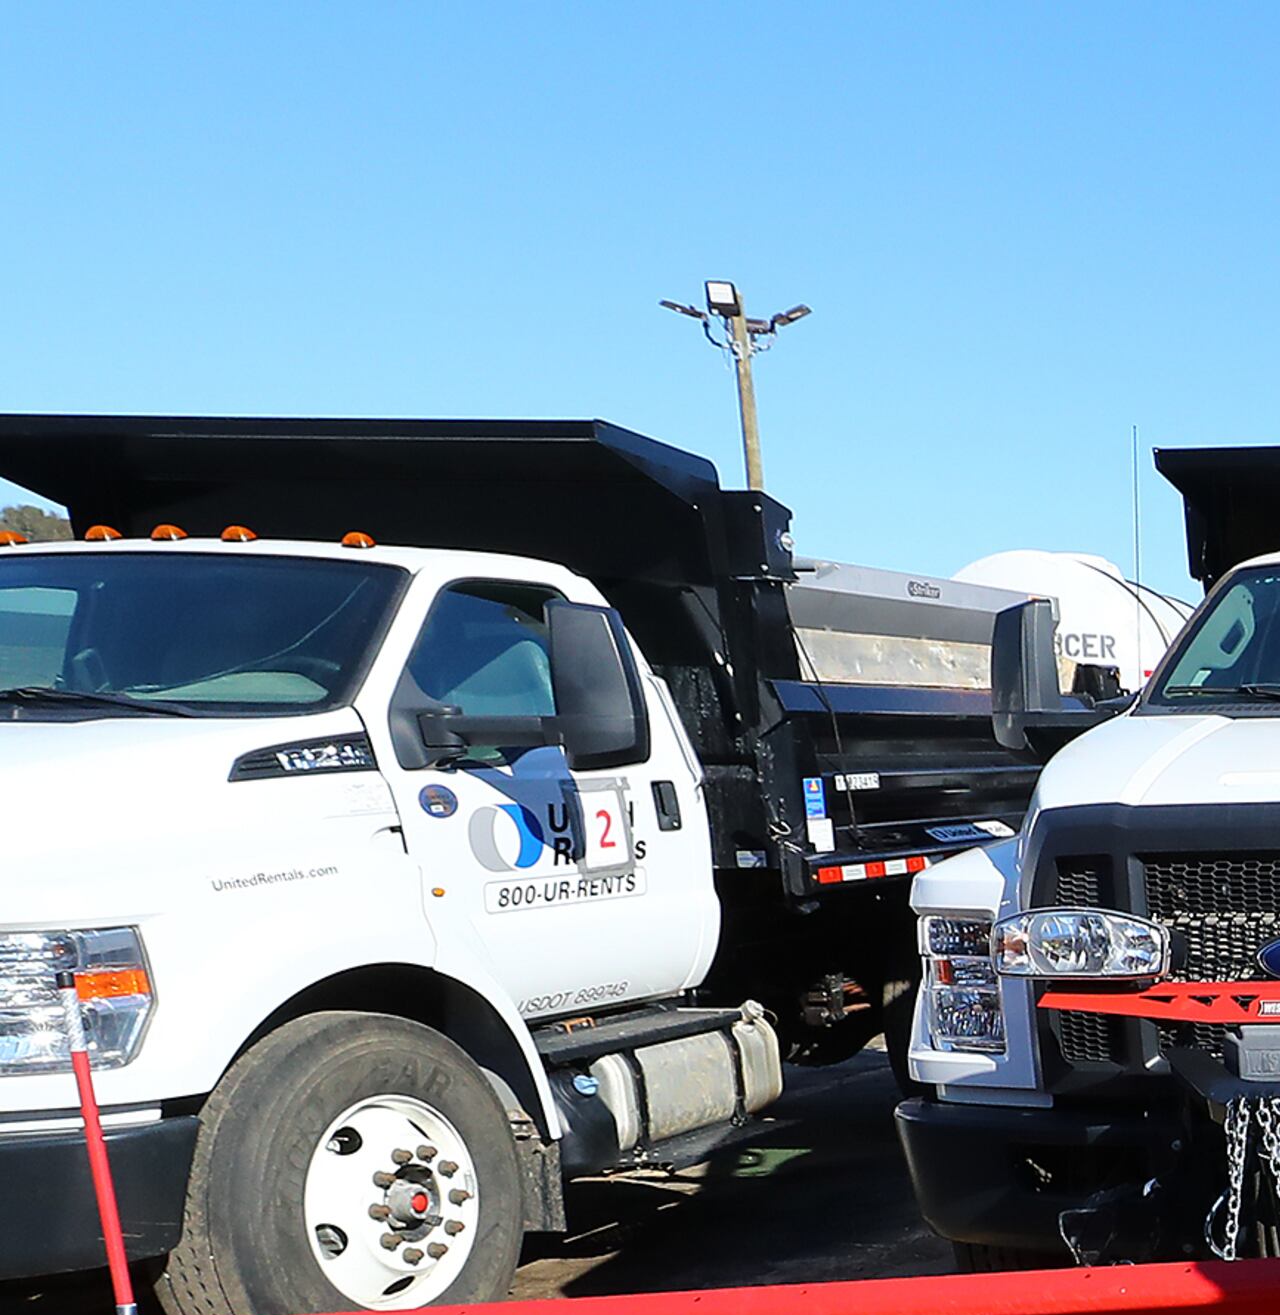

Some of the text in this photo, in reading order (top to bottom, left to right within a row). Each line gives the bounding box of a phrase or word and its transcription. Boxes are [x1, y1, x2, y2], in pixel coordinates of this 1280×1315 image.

[595, 809, 616, 848] 2
[211, 865, 338, 891] UnitedRentals.com
[498, 873, 636, 908] 800-UR-RENTS
[517, 991, 573, 1014] USDOT
